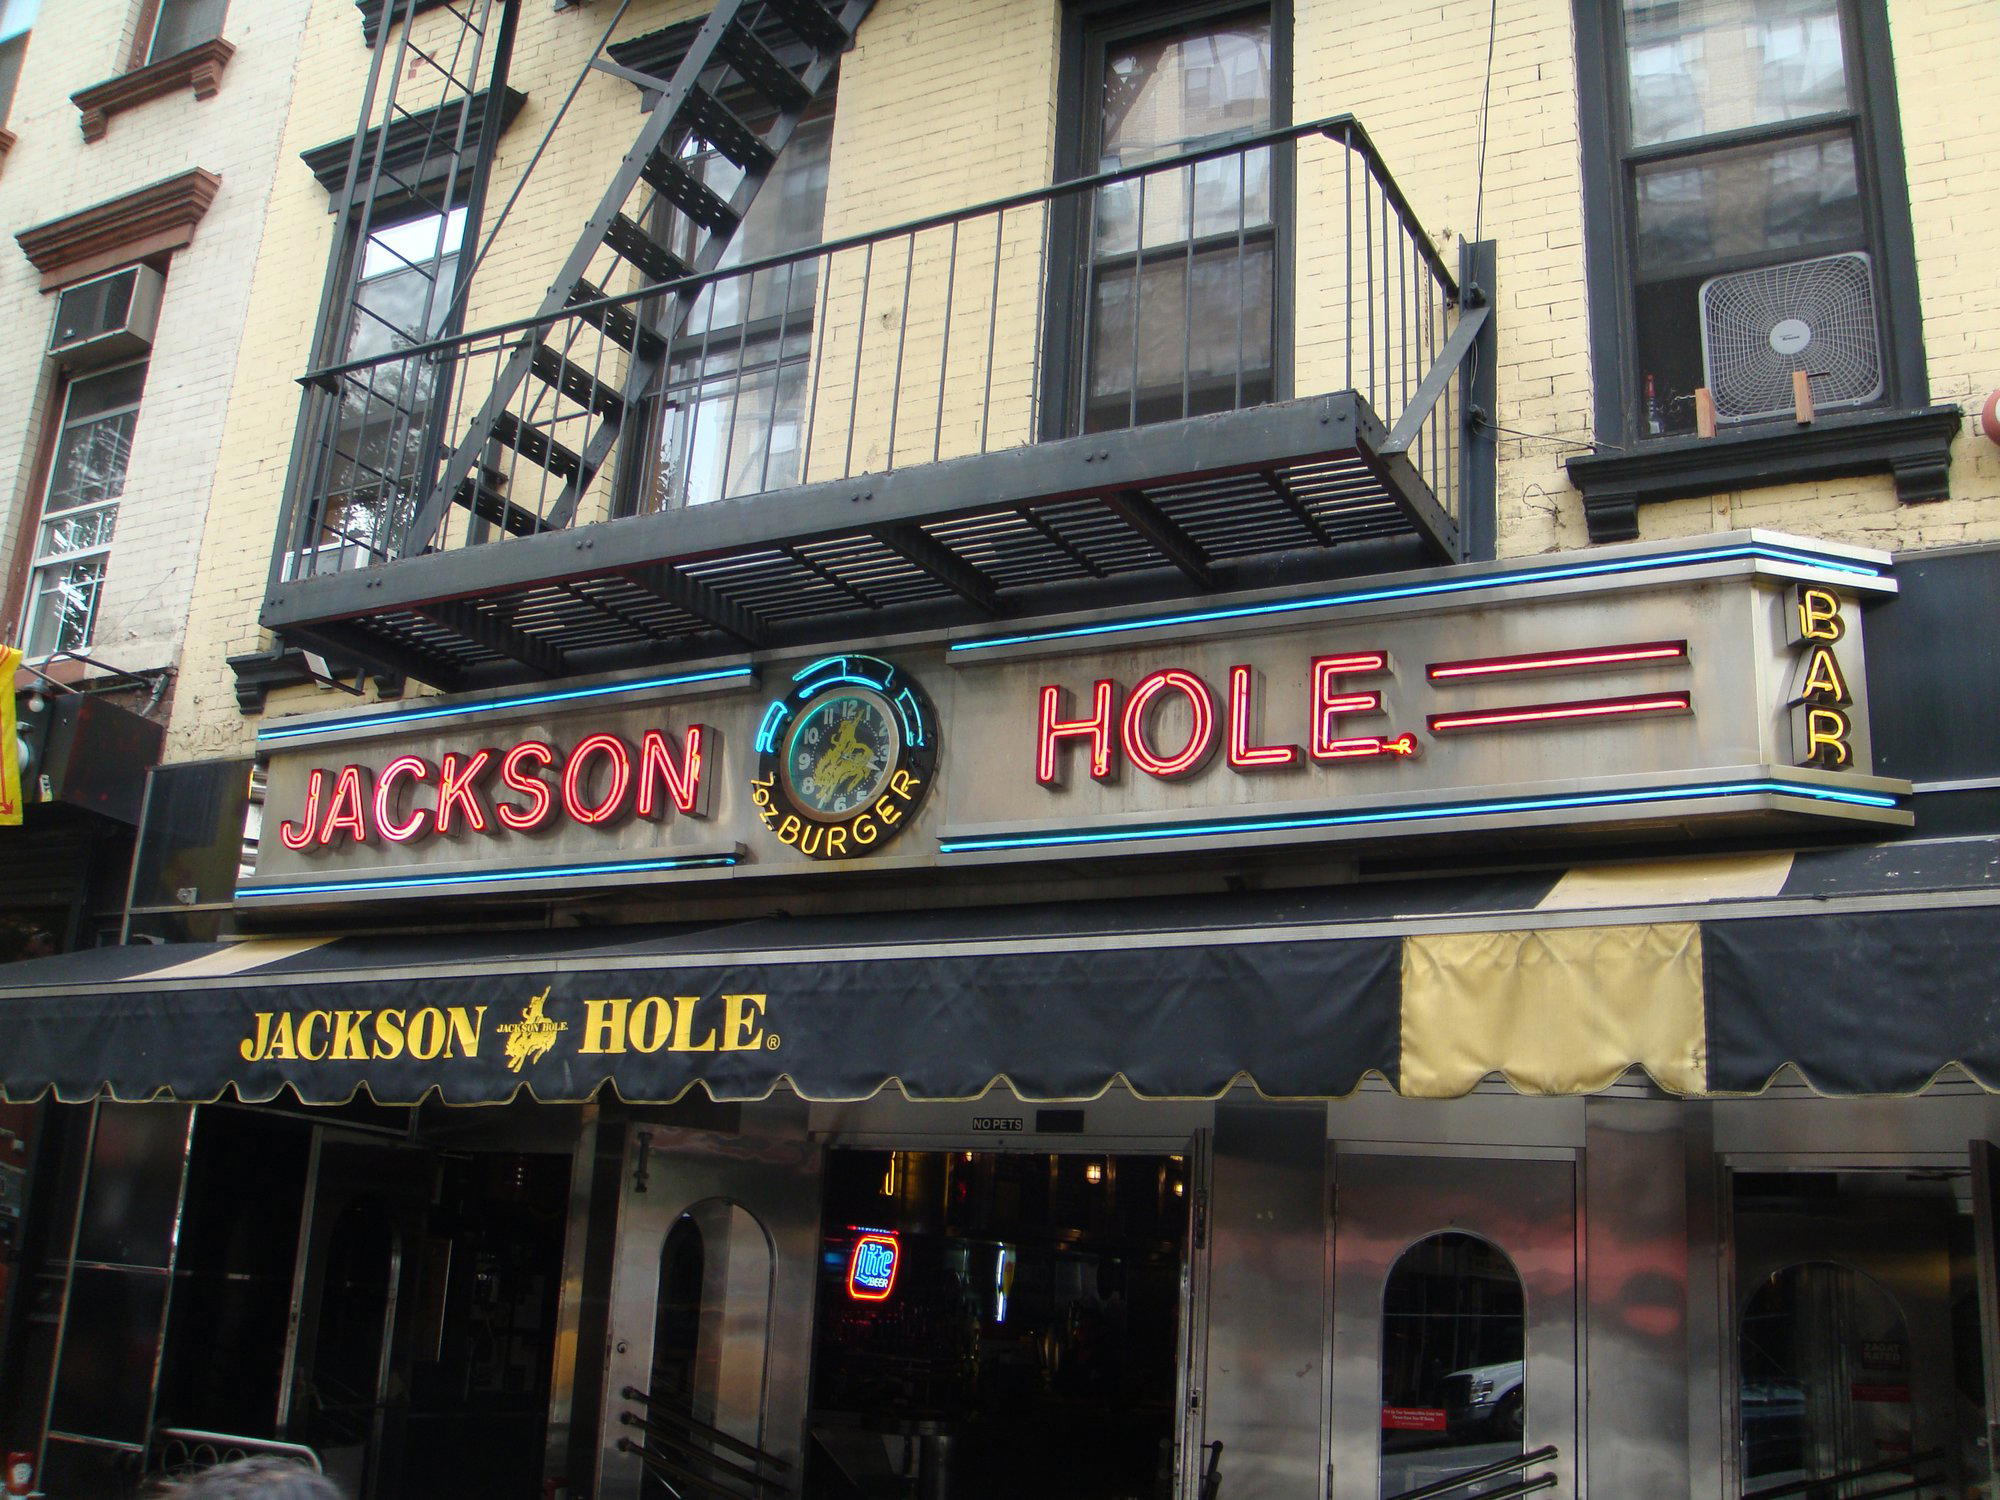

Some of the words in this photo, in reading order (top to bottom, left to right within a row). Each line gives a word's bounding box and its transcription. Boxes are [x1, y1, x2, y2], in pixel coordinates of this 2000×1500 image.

[1796, 584, 1853, 768] BAR
[798, 753, 811, 770] 9
[281, 723, 706, 850] JACKSON
[801, 777, 815, 795] 8
[777, 769, 920, 857] BURGER
[240, 1006, 488, 1062] JACKSON
[496, 1022, 540, 1034] JACKSON
[973, 1118, 991, 1130] NO
[992, 1119, 1022, 1130] PETS
[855, 1243, 894, 1284] Lite
[868, 1276, 889, 1288] BEER
